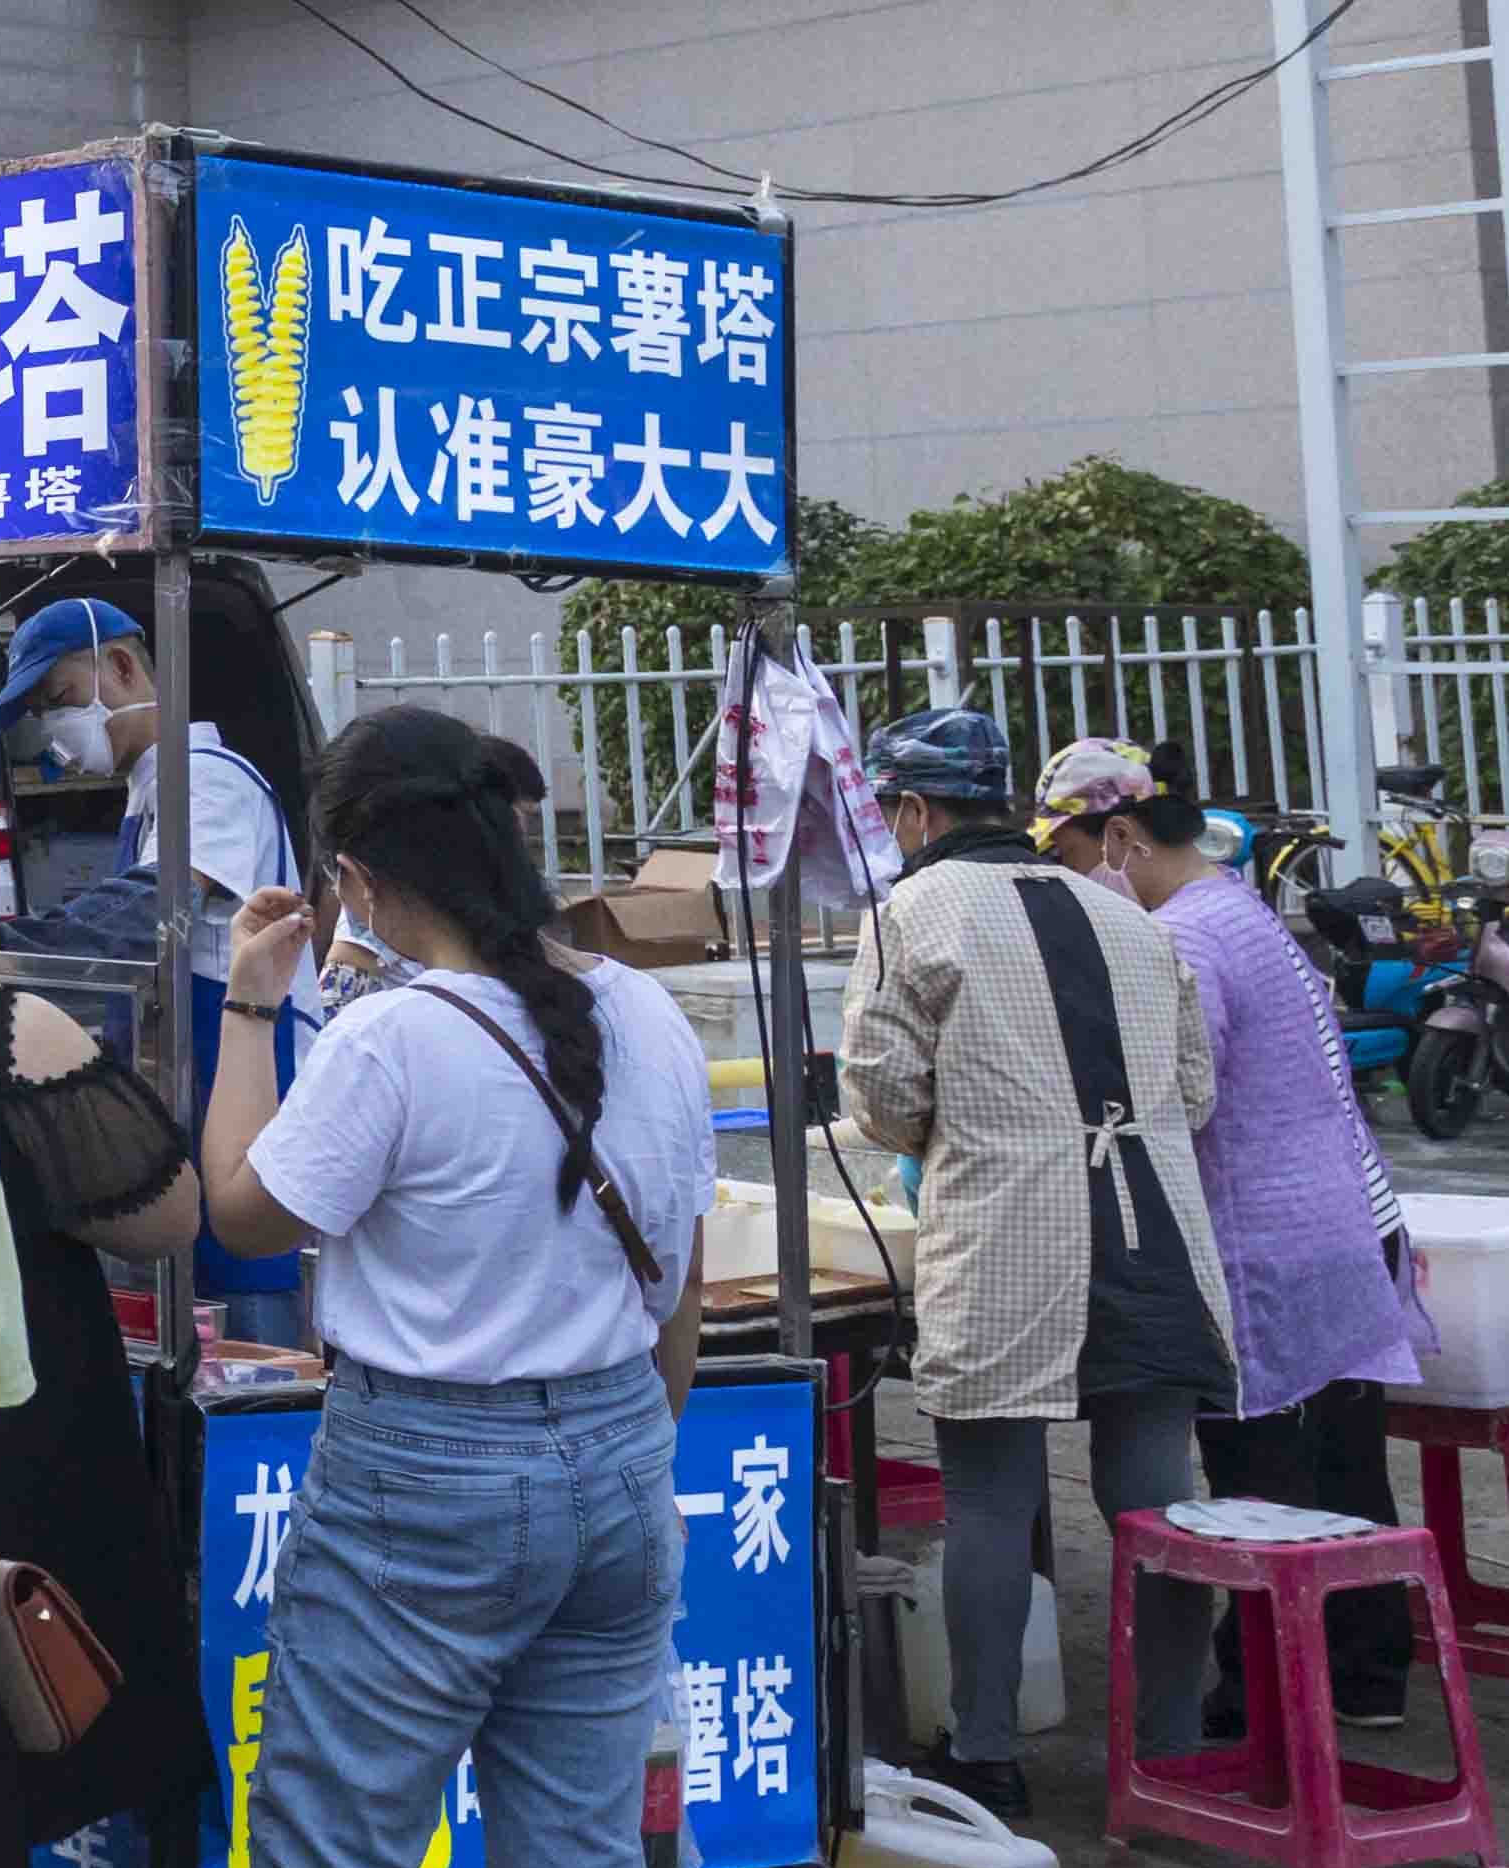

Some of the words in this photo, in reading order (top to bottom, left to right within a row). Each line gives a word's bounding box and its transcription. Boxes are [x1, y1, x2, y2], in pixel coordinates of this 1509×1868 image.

[326, 216, 776, 386] 吃正宗薯塔
[330, 386, 779, 545] 认准豪大大
